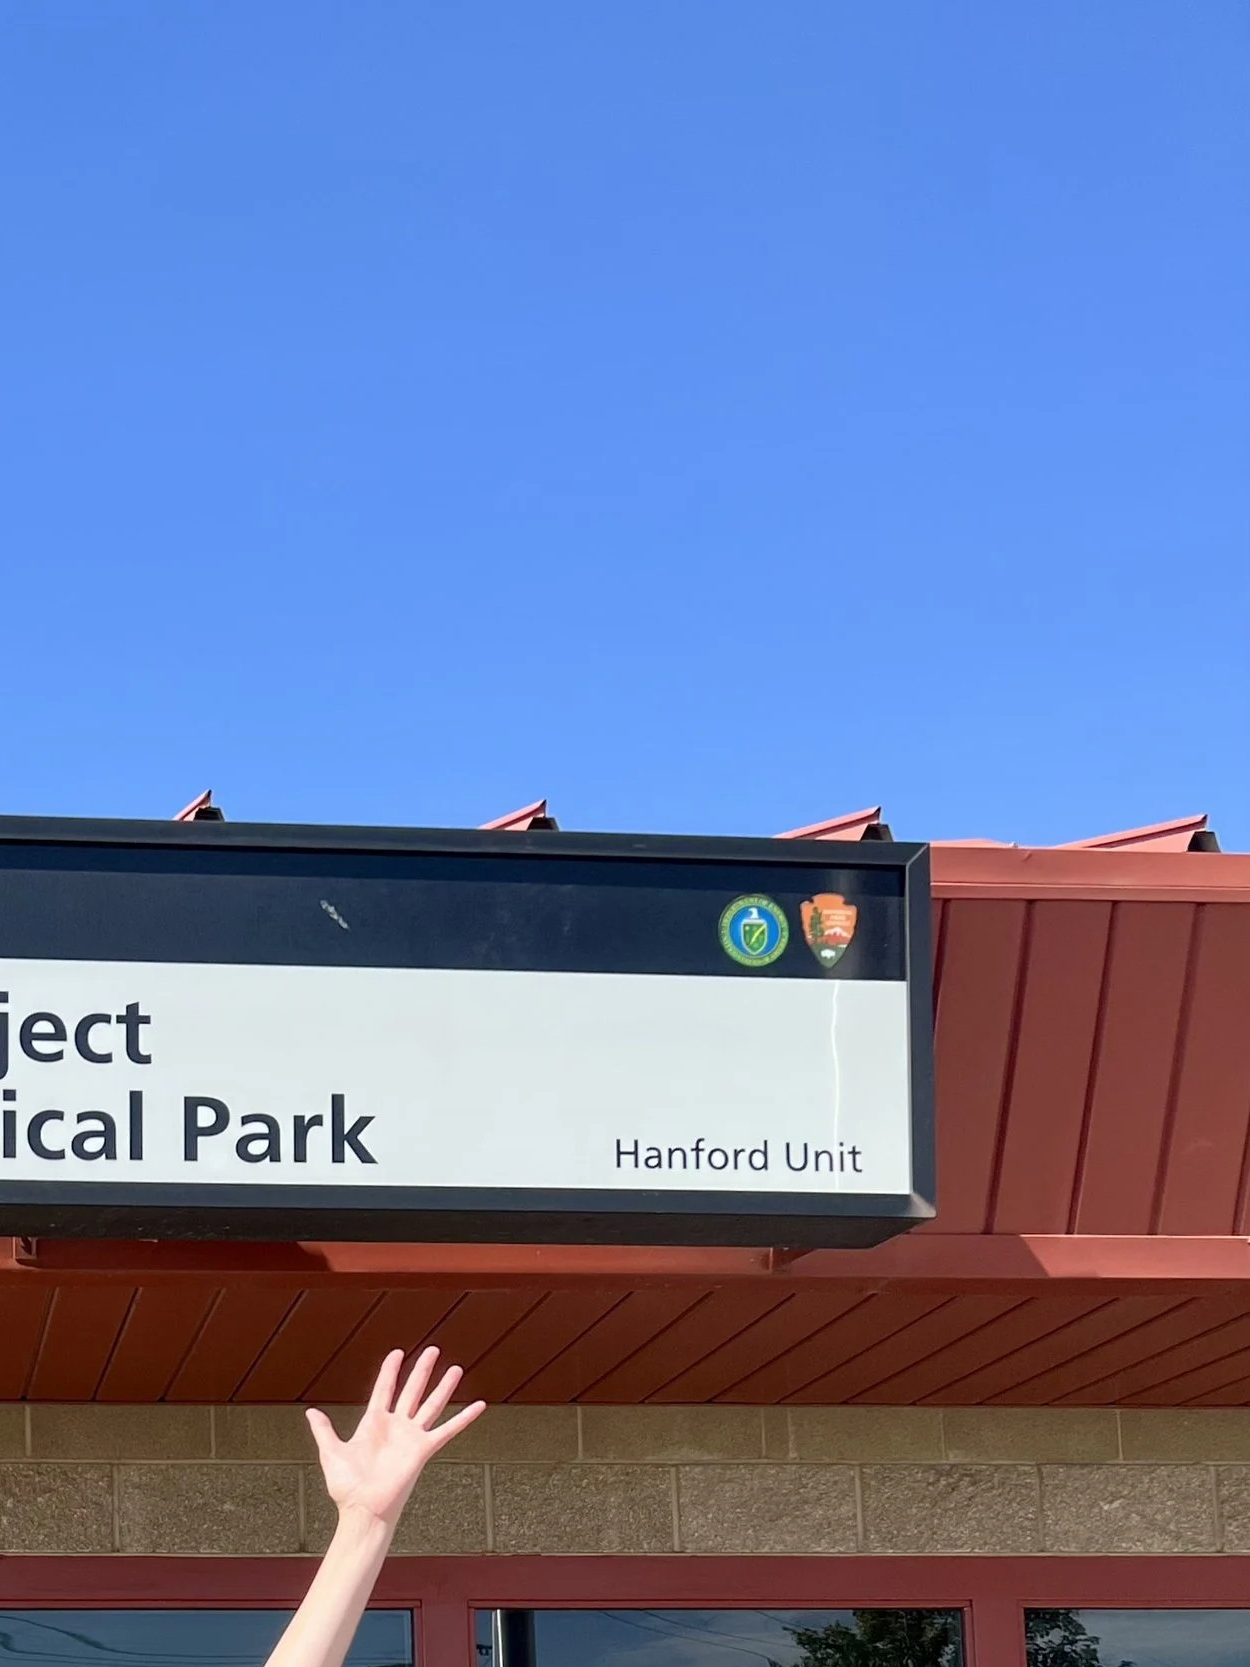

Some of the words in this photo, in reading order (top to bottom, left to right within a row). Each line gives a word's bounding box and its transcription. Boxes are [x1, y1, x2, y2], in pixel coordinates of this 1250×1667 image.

[183, 1093, 379, 1165] Park
[616, 1137, 769, 1171] Hanford
[785, 1142, 864, 1173] Unit
